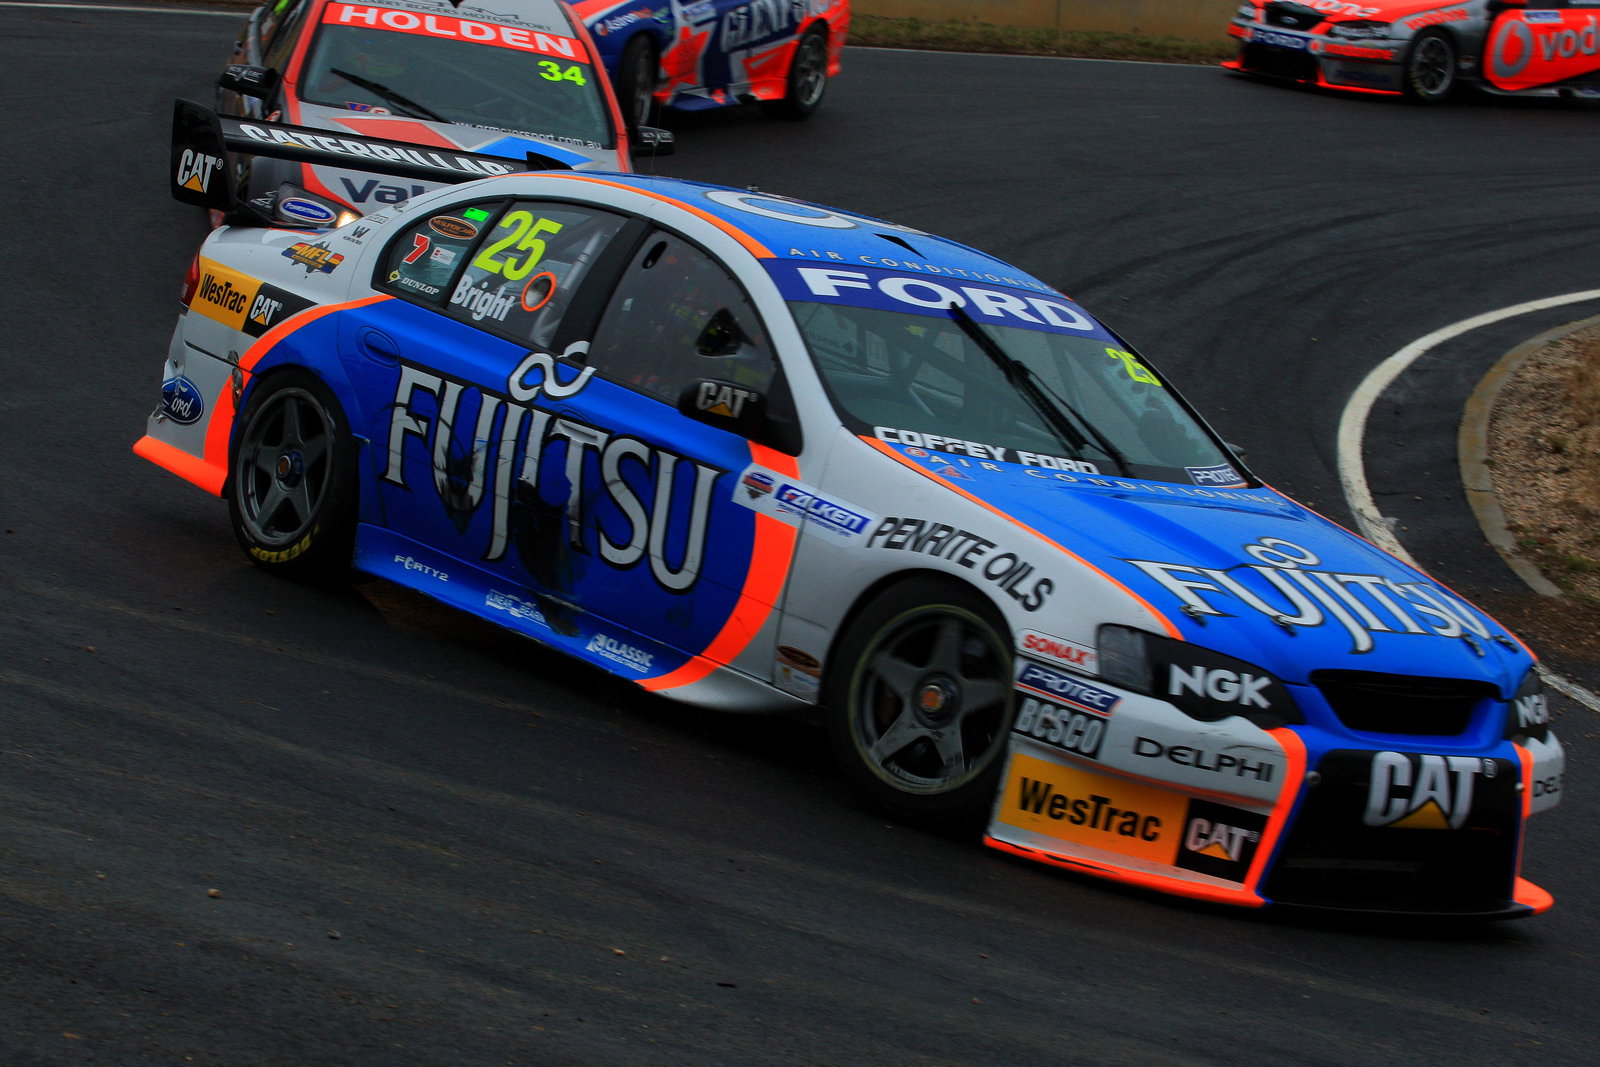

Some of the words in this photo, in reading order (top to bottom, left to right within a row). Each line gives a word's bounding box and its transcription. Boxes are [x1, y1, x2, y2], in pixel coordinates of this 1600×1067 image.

[339, 5, 576, 58] HOLDEN
[537, 60, 587, 87] 34
[177, 148, 217, 194] CAT
[296, 244, 332, 265] MFL
[473, 210, 564, 282] 25
[199, 273, 247, 314] WesTrac
[401, 276, 440, 296] DUNLOP
[789, 247, 846, 261] AIR
[859, 255, 1060, 295] CONDITIONING
[250, 294, 279, 326] CAT
[450, 274, 516, 322] Bright
[796, 267, 1095, 332] FORD
[1105, 347, 1163, 388] 25
[695, 381, 750, 419] CAT
[874, 425, 1008, 463] COFFEY
[1015, 449, 1101, 476] FORD
[384, 364, 726, 592] FUJITSU
[928, 455, 1004, 474] AIR
[1023, 468, 1288, 508] CONDITIONING
[781, 489, 868, 532] FALKEN
[866, 516, 999, 569] PENRITE
[983, 552, 1055, 613] OILS
[1122, 557, 1493, 654] FUJITSU
[605, 637, 655, 668] CLASSIC
[1023, 634, 1090, 666] SONAX
[1022, 667, 1116, 709] PROTEC
[1167, 662, 1273, 710] NGK
[1132, 735, 1276, 783] DELPHI
[1018, 776, 1162, 842] WesTrac
[1361, 750, 1482, 830] CAT
[1184, 818, 1248, 863] CAT
